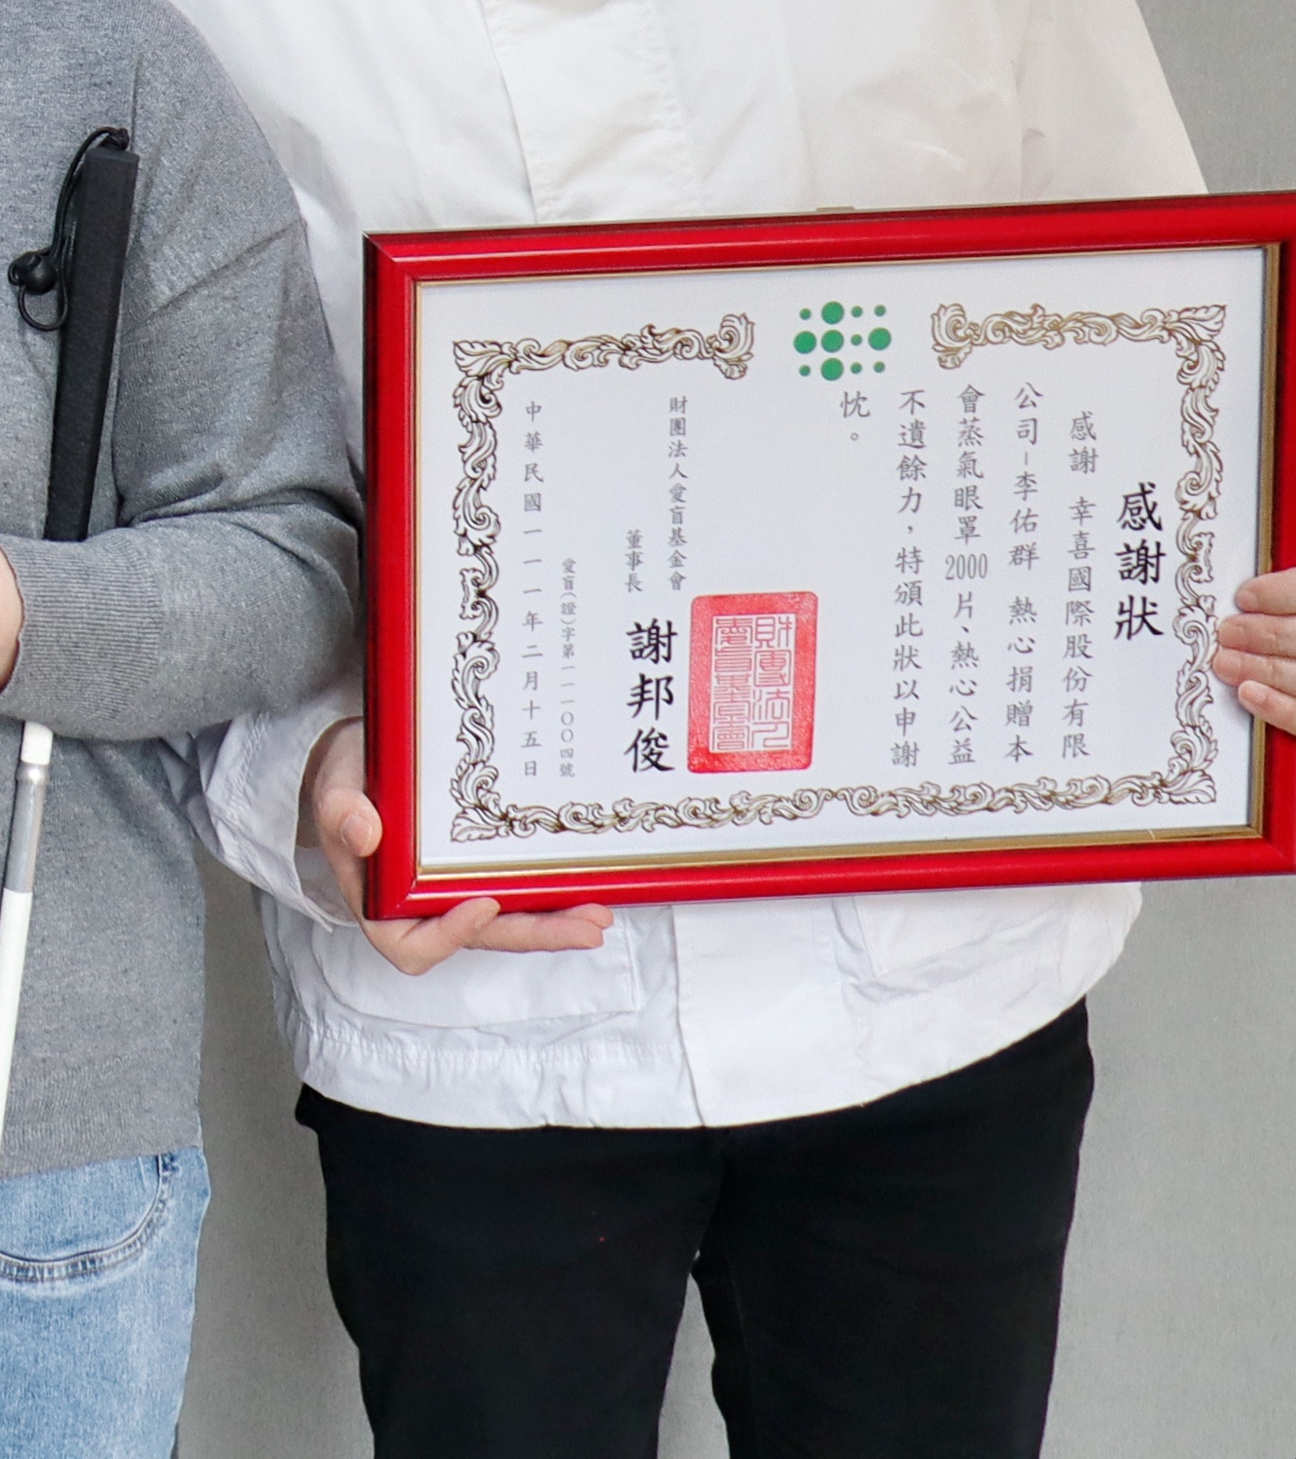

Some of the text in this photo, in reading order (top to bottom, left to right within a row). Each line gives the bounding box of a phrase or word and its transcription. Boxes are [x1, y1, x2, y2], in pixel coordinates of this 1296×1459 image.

[668, 395, 689, 591] 財團法人愛盲基金會
[1068, 411, 1099, 475] 感謝
[521, 401, 544, 777] 中華民國一一一年二月十五日
[623, 529, 679, 774] 董事長 謝邦俊
[1113, 481, 1167, 642] 感謝狀
[1004, 596, 1038, 763] 熱心捐贈本
